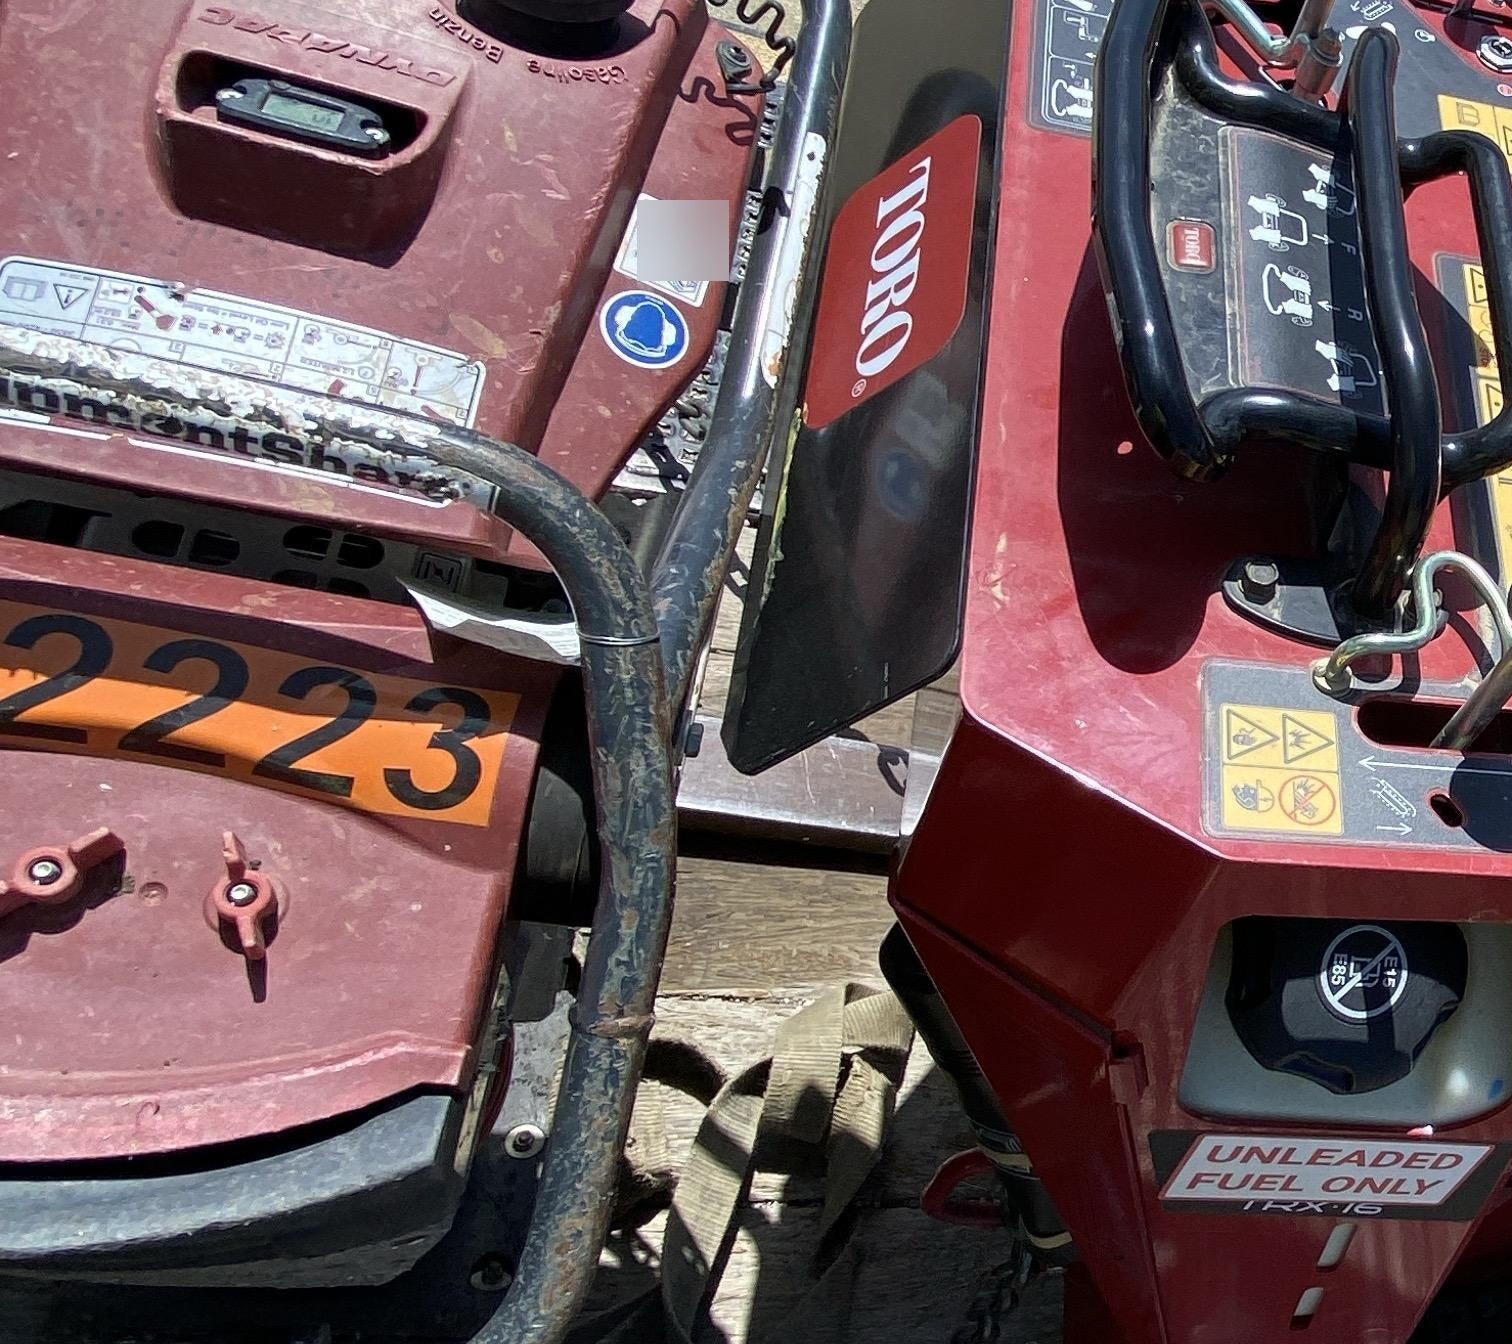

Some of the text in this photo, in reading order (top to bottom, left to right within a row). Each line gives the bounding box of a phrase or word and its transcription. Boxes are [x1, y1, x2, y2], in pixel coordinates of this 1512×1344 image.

[198, 5, 458, 86] DYNAPAC
[428, 6, 505, 65] Benzin
[855, 156, 931, 377] TORO
[0, 613, 492, 810] 2223
[1331, 953, 1348, 985] E85
[1382, 956, 1398, 987] E15
[1206, 1145, 1463, 1170] UNLEADED
[1186, 1172, 1443, 1196] FUEL ONLY
